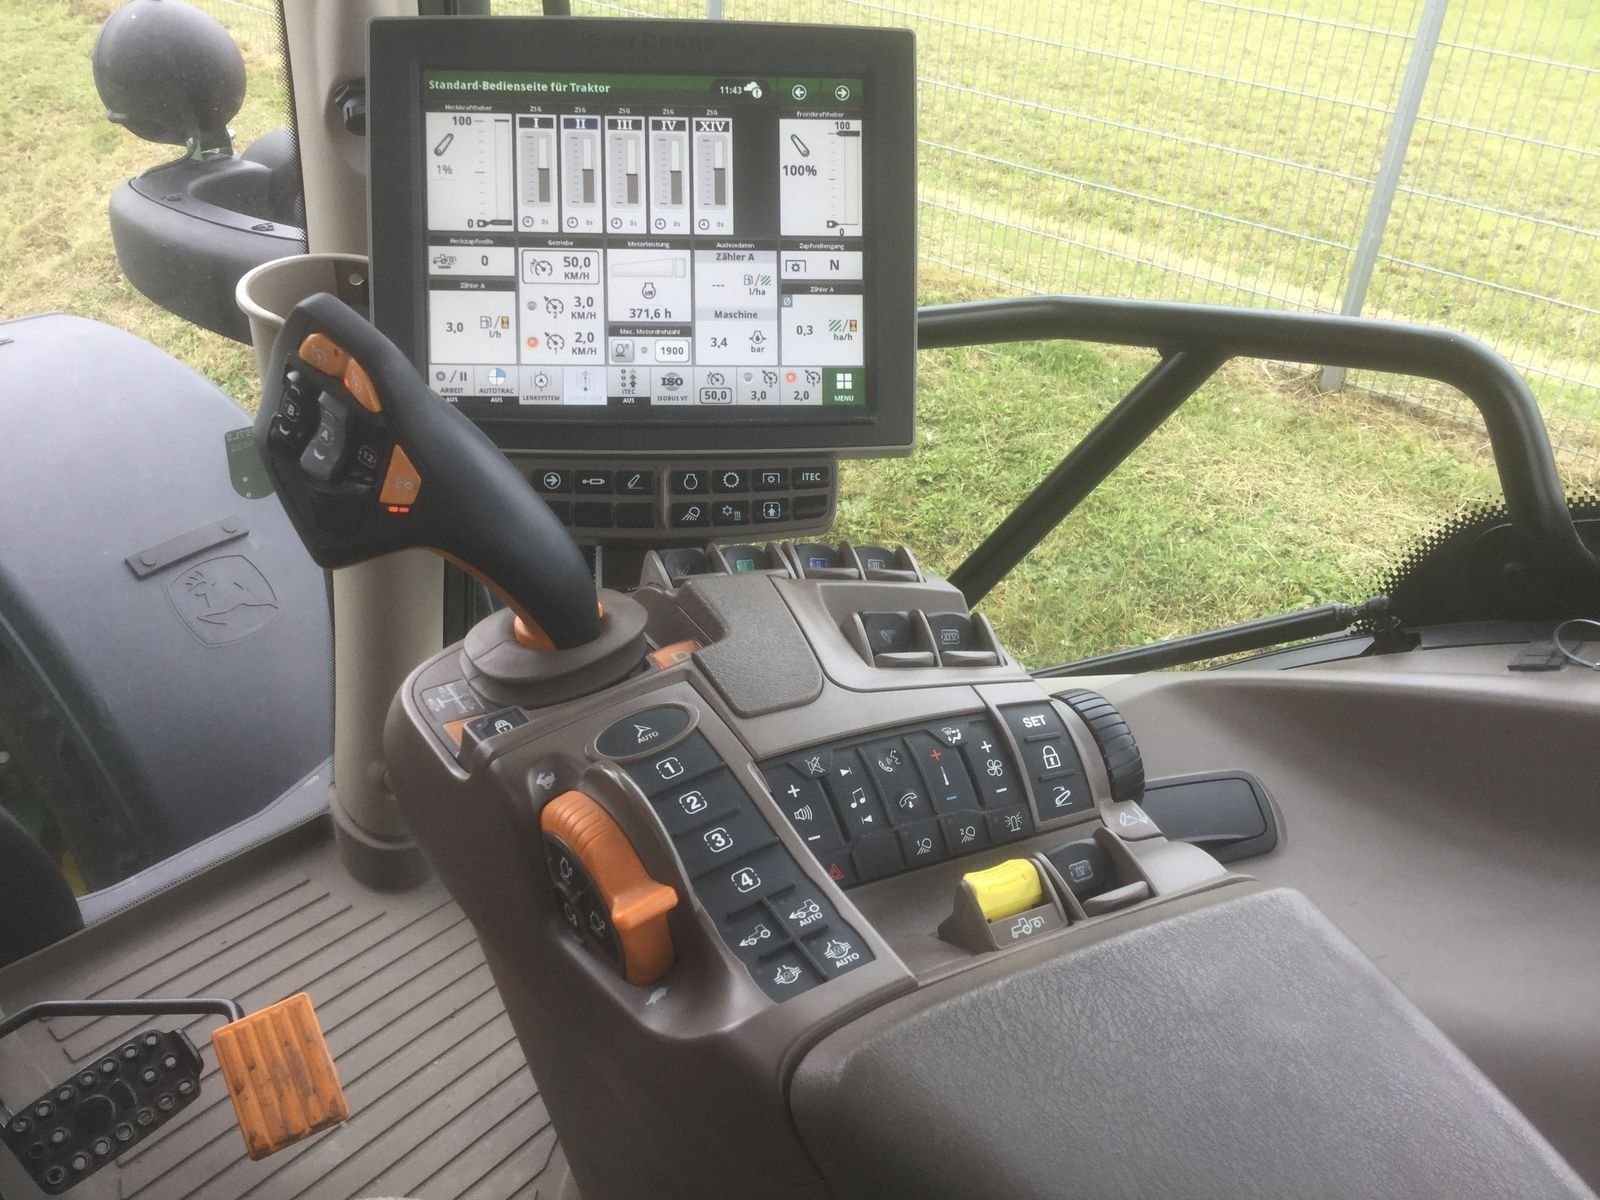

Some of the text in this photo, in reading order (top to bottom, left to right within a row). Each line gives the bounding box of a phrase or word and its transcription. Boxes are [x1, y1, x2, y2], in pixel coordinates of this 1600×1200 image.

[428, 80, 611, 94] Standard-Bedienseite für Traktor
[720, 86, 742, 95] 11:43
[452, 116, 472, 126] 100
[575, 119, 586, 129] II
[616, 119, 633, 130] III
[661, 120, 677, 131] IV
[700, 121, 726, 132] XIV
[835, 121, 850, 130] 100
[437, 165, 453, 175] 1%
[783, 165, 817, 176] 100%
[467, 219, 474, 228] 0
[839, 228, 844, 236] 0
[481, 255, 488, 266] 0
[716, 252, 754, 261] Zähler A
[563, 257, 591, 269] 50,0
[830, 260, 839, 270] N
[564, 272, 590, 280] KM/H
[574, 297, 594, 309] 3,0
[629, 308, 671, 320] 371,6 h
[714, 310, 758, 319] Maschine
[446, 322, 464, 334] 3,0
[796, 325, 813, 336] 0,3
[575, 332, 594, 345] 2,0
[710, 337, 728, 348] 3,4
[661, 347, 684, 355] 1900
[661, 377, 684, 386] ISO
[704, 391, 727, 401] 50,0
[751, 391, 766, 401] 3,0
[794, 391, 809, 401] 2,0
[802, 471, 821, 481] iTEC
[1022, 713, 1047, 729] SET
[637, 730, 659, 744] AUTO
[663, 762, 676, 774] 1
[685, 795, 702, 810] 2
[711, 832, 726, 848] 3
[740, 872, 754, 887] 4
[799, 911, 823, 928] AUTO
[835, 952, 860, 968] AUTO
